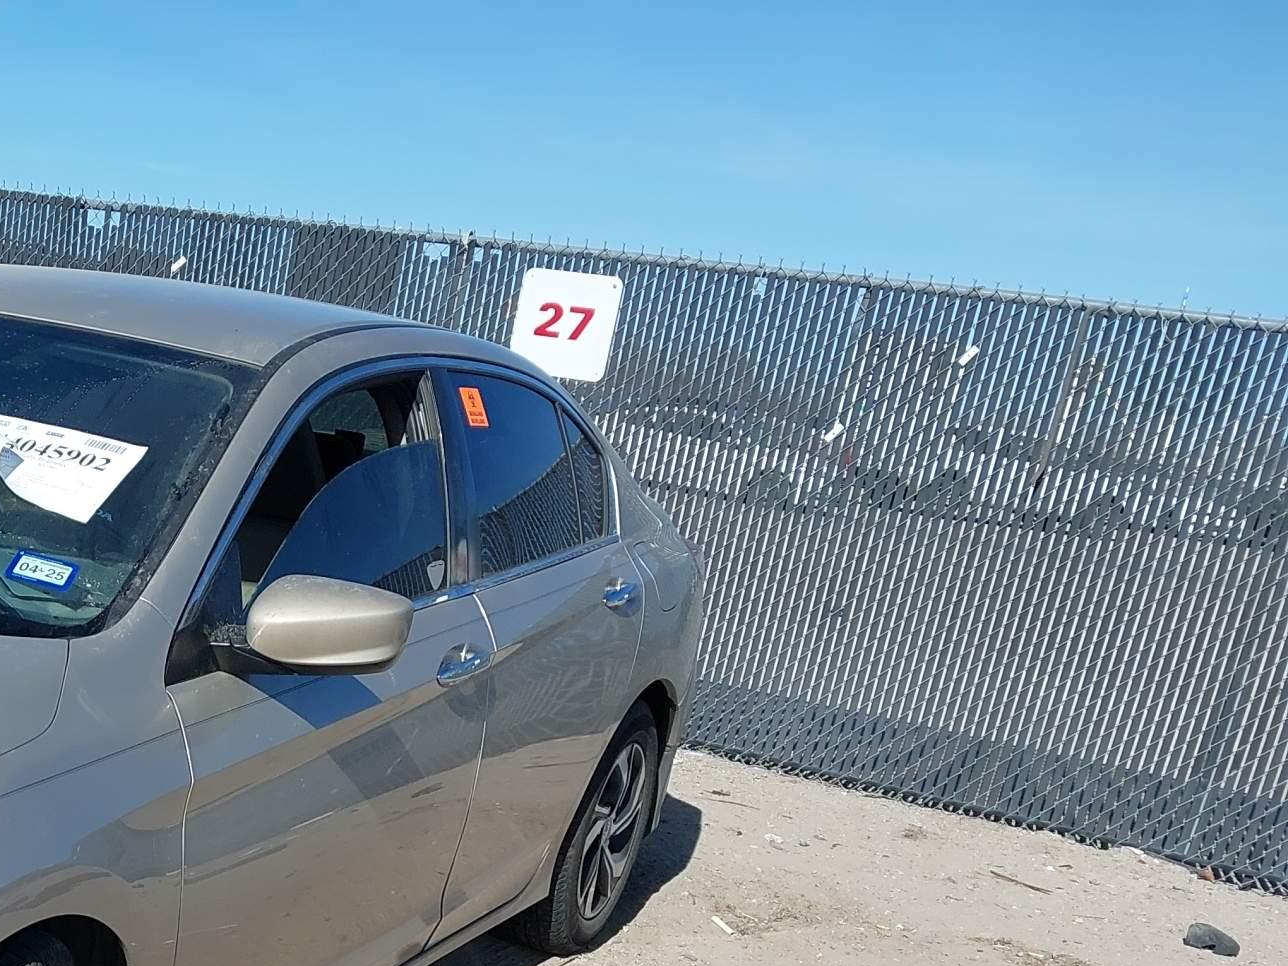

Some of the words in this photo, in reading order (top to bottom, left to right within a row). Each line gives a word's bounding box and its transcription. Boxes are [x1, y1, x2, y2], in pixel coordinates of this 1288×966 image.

[533, 302, 596, 341] 27
[19, 562, 39, 574] 04
[44, 568, 66, 581] 25
